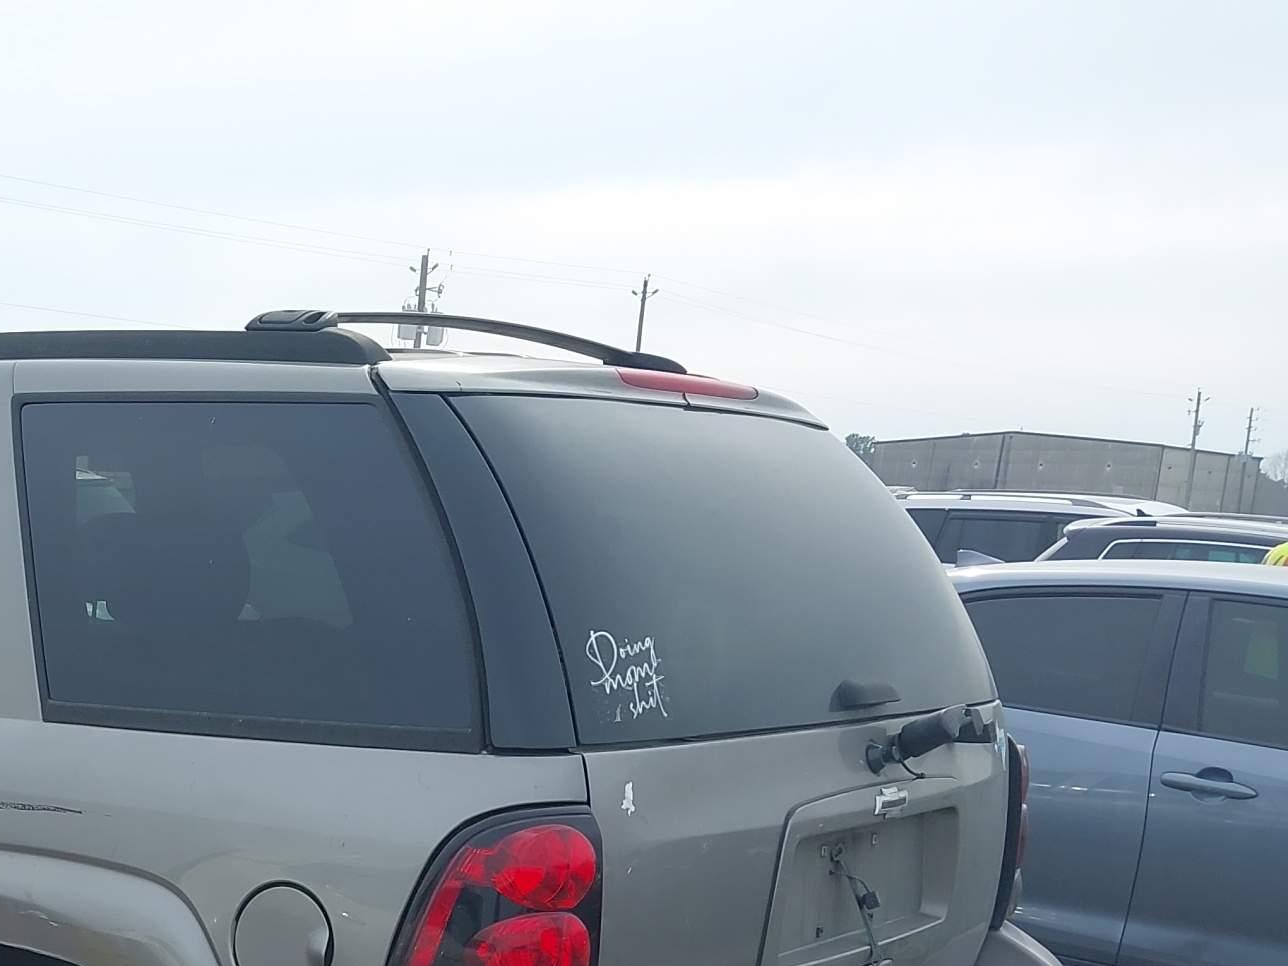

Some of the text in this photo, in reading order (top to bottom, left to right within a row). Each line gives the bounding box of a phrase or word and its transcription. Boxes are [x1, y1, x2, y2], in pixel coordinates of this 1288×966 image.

[585, 630, 658, 684] Doing
[604, 660, 658, 695] mom
[628, 674, 668, 719] shit
